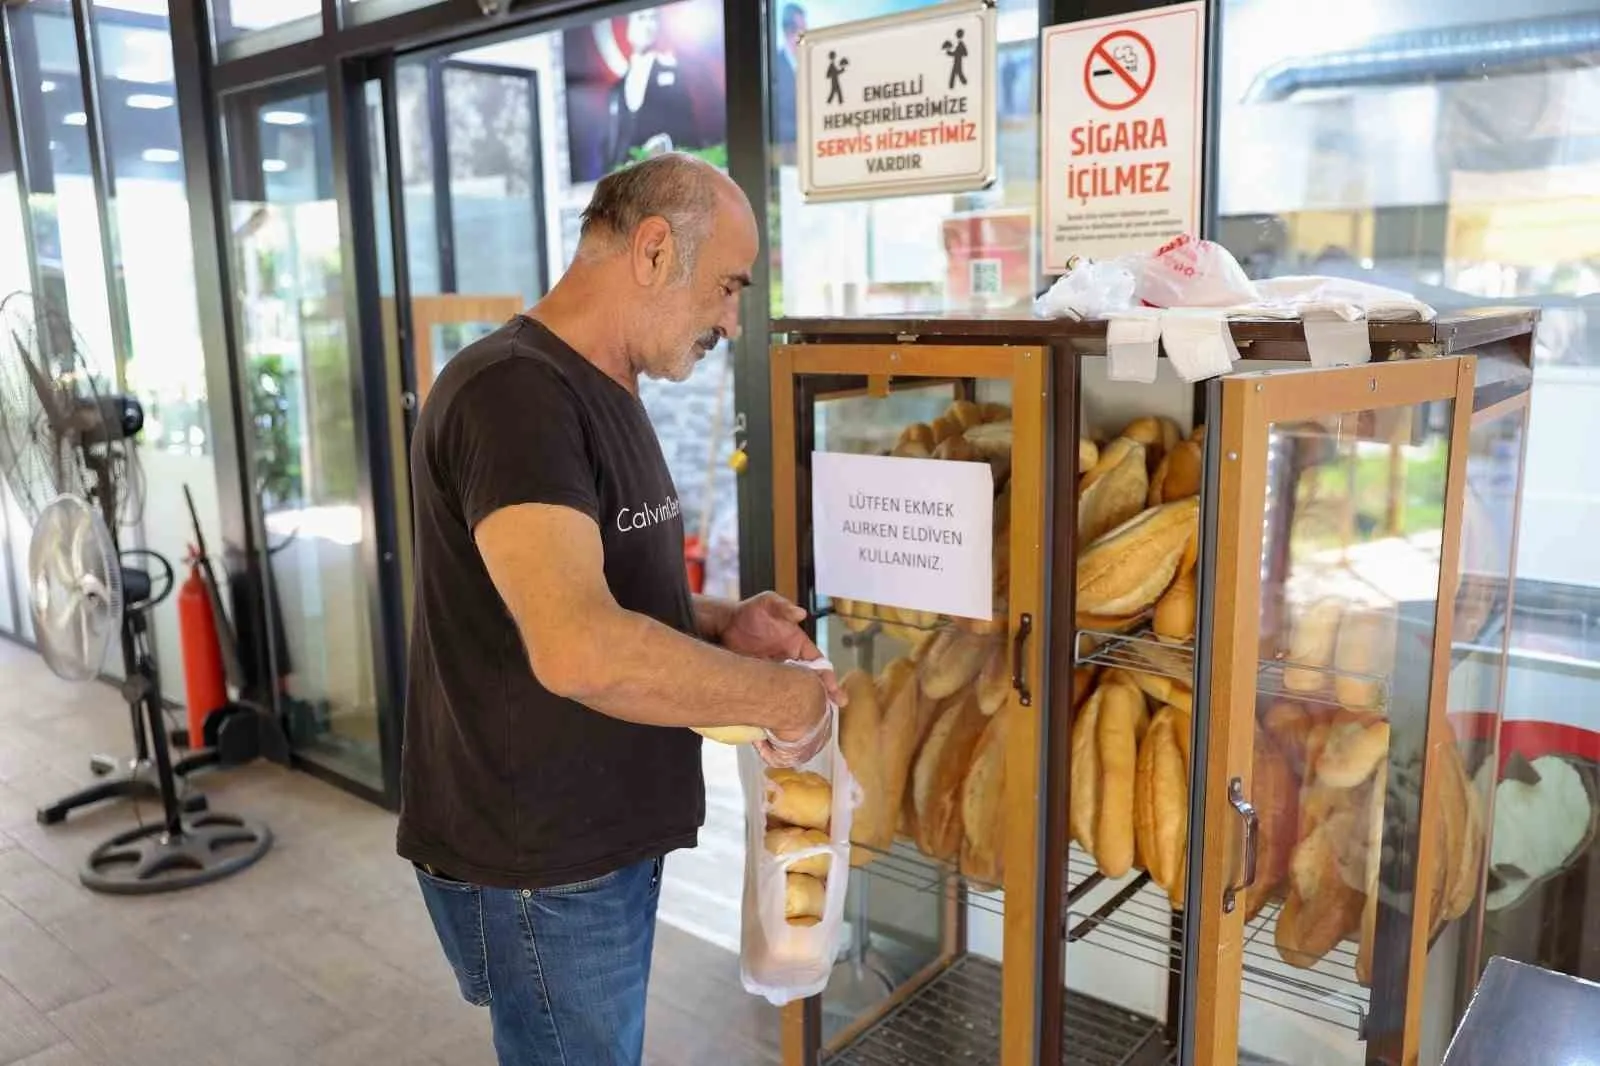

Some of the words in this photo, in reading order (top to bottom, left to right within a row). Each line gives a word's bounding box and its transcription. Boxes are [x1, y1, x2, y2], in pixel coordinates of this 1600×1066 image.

[864, 74, 924, 102] ENGELLİ
[824, 97, 967, 130] HEMŞEHRİLERİMİZE
[817, 131, 872, 157] SERVİS
[877, 120, 976, 151] HİZMETİMİZ
[1071, 118, 1168, 156] SİGARA
[866, 154, 922, 173] VARDIR
[1067, 162, 1171, 205] İÇİLMEZ
[849, 490, 900, 513] LÜTFEN
[905, 499, 954, 518] EKMEK
[842, 520, 898, 540] ALIRKEN
[903, 525, 963, 545] ELDİVEN
[858, 547, 944, 572] KULLANINIZ.
